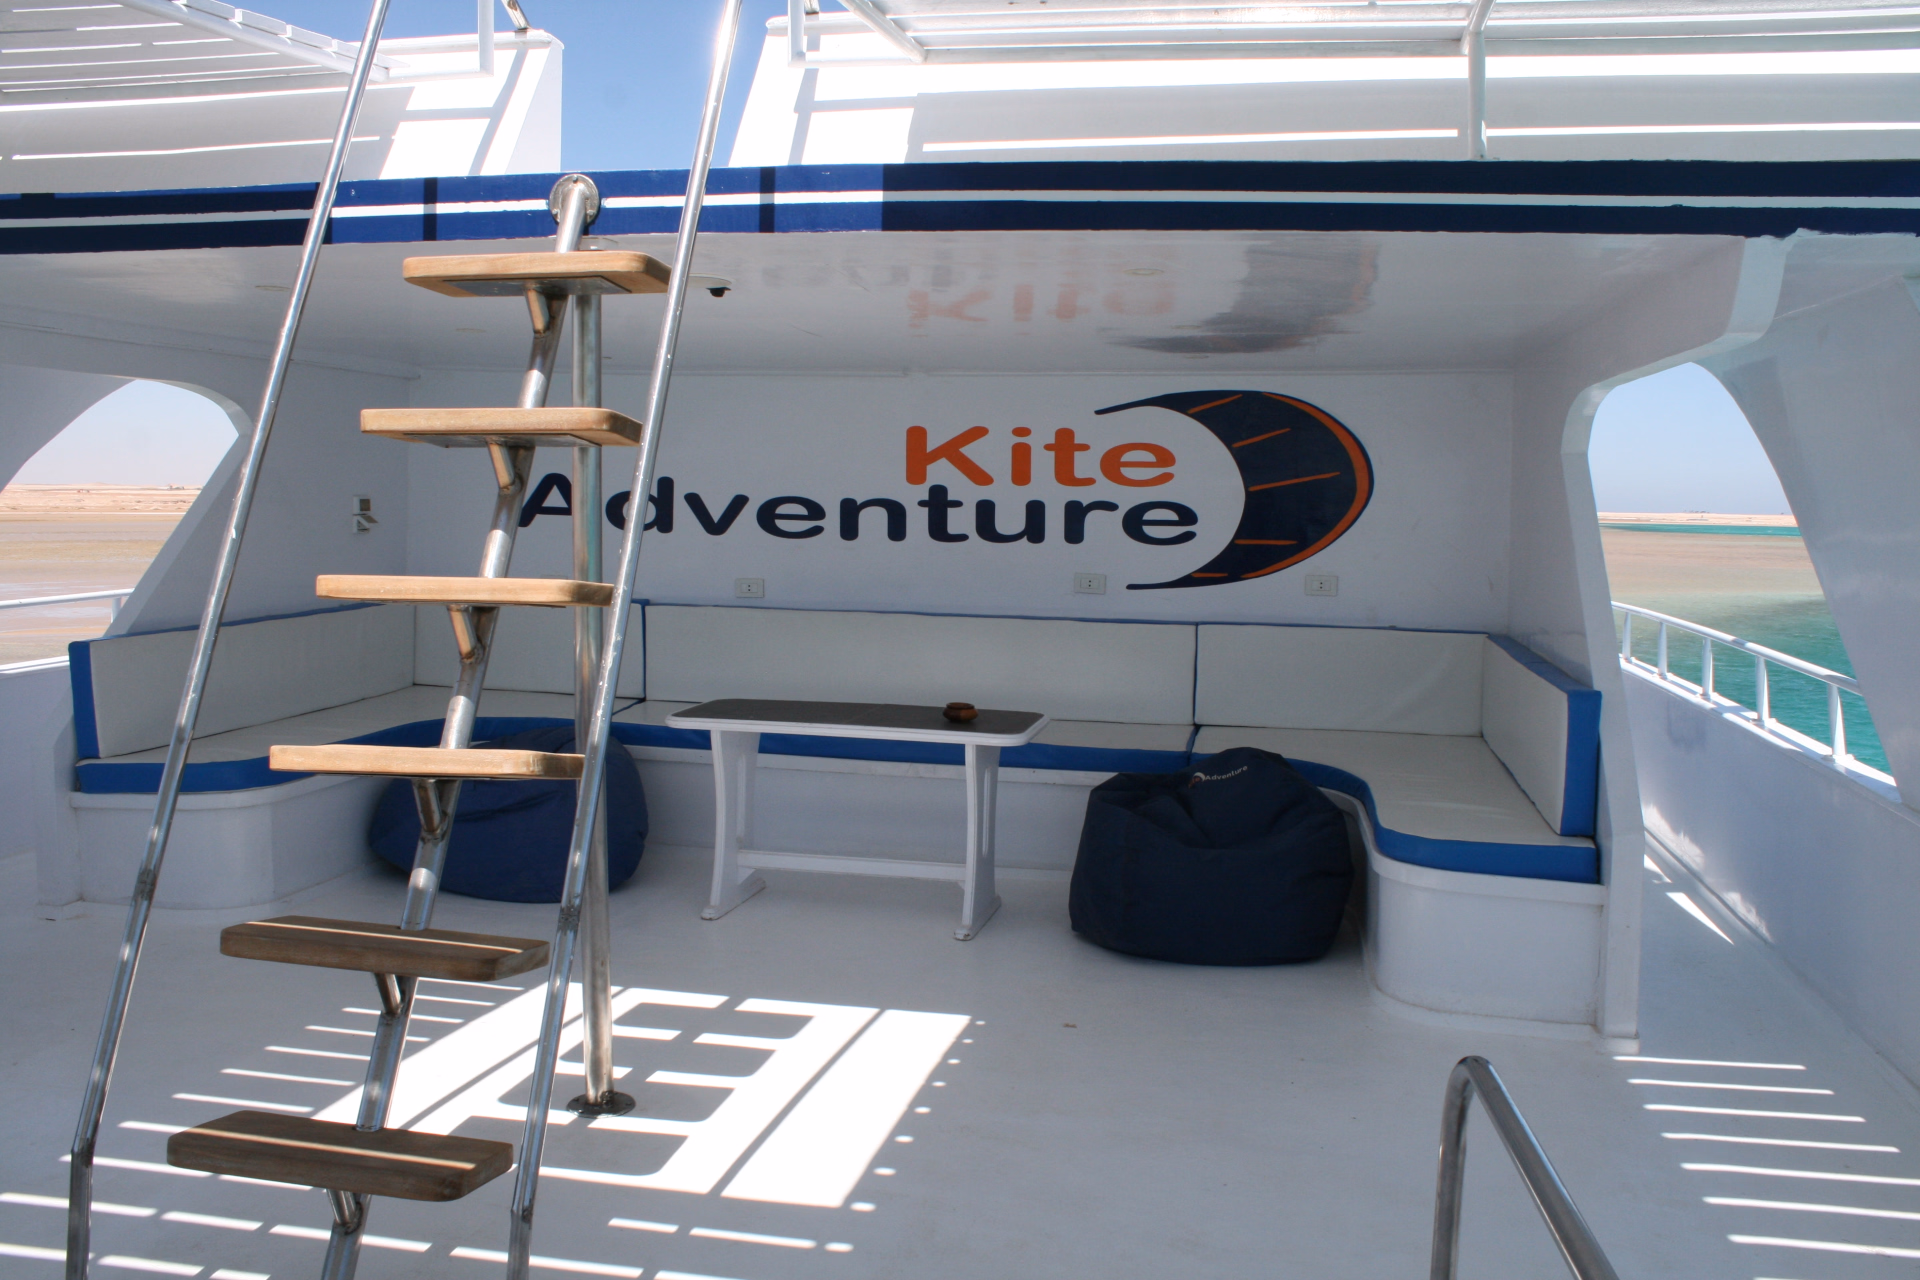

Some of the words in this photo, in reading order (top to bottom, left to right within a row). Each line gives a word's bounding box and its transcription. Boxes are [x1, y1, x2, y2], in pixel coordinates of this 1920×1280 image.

[906, 426, 1176, 487] Kite
[518, 472, 1199, 546] Adventure
[1205, 765, 1248, 781] Adventure
